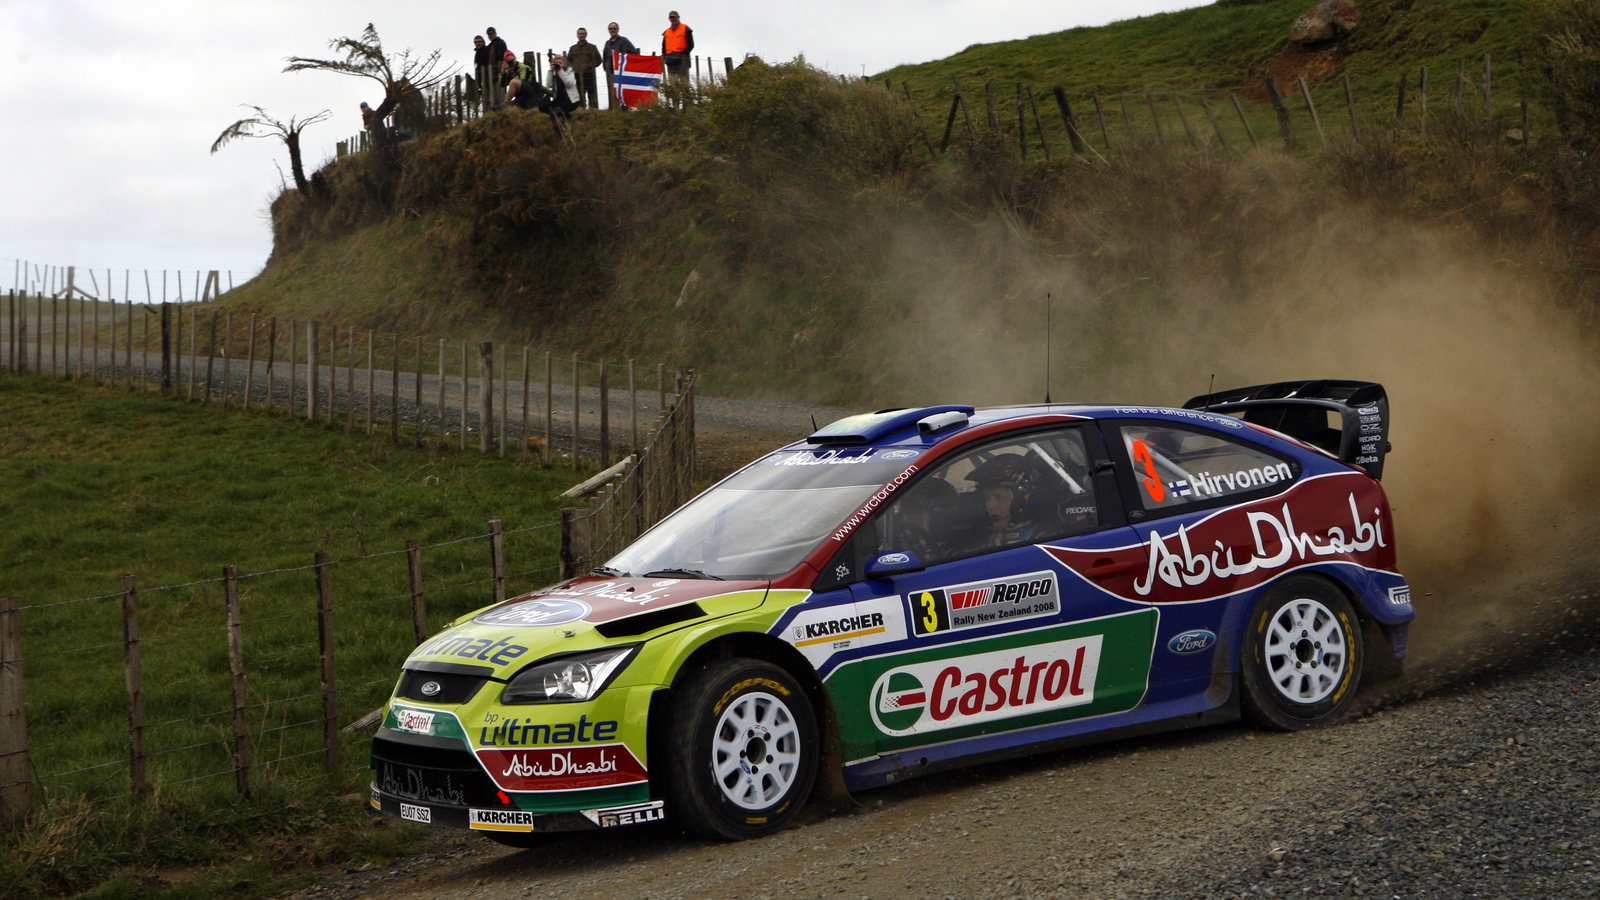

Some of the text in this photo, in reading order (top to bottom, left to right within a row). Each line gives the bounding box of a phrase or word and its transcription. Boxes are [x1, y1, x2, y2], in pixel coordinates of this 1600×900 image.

[1160, 408, 1215, 422] difference
[1132, 439, 1166, 503] 3
[1189, 462, 1293, 497] Hirvonen
[832, 464, 919, 542] www.wrcford.com
[920, 578, 1052, 633] 3 Repco
[954, 602, 1055, 626] Rally New Zealand 2008
[805, 612, 884, 639] KÄRCHER
[1176, 633, 1208, 651] Ford
[930, 645, 1086, 722] Castrol
[404, 712, 431, 730] Castrol
[479, 715, 618, 746] ultimate
[484, 712, 499, 724] bp
[401, 805, 430, 821] EU07 SSZ
[477, 810, 532, 825] KÄRCHER
